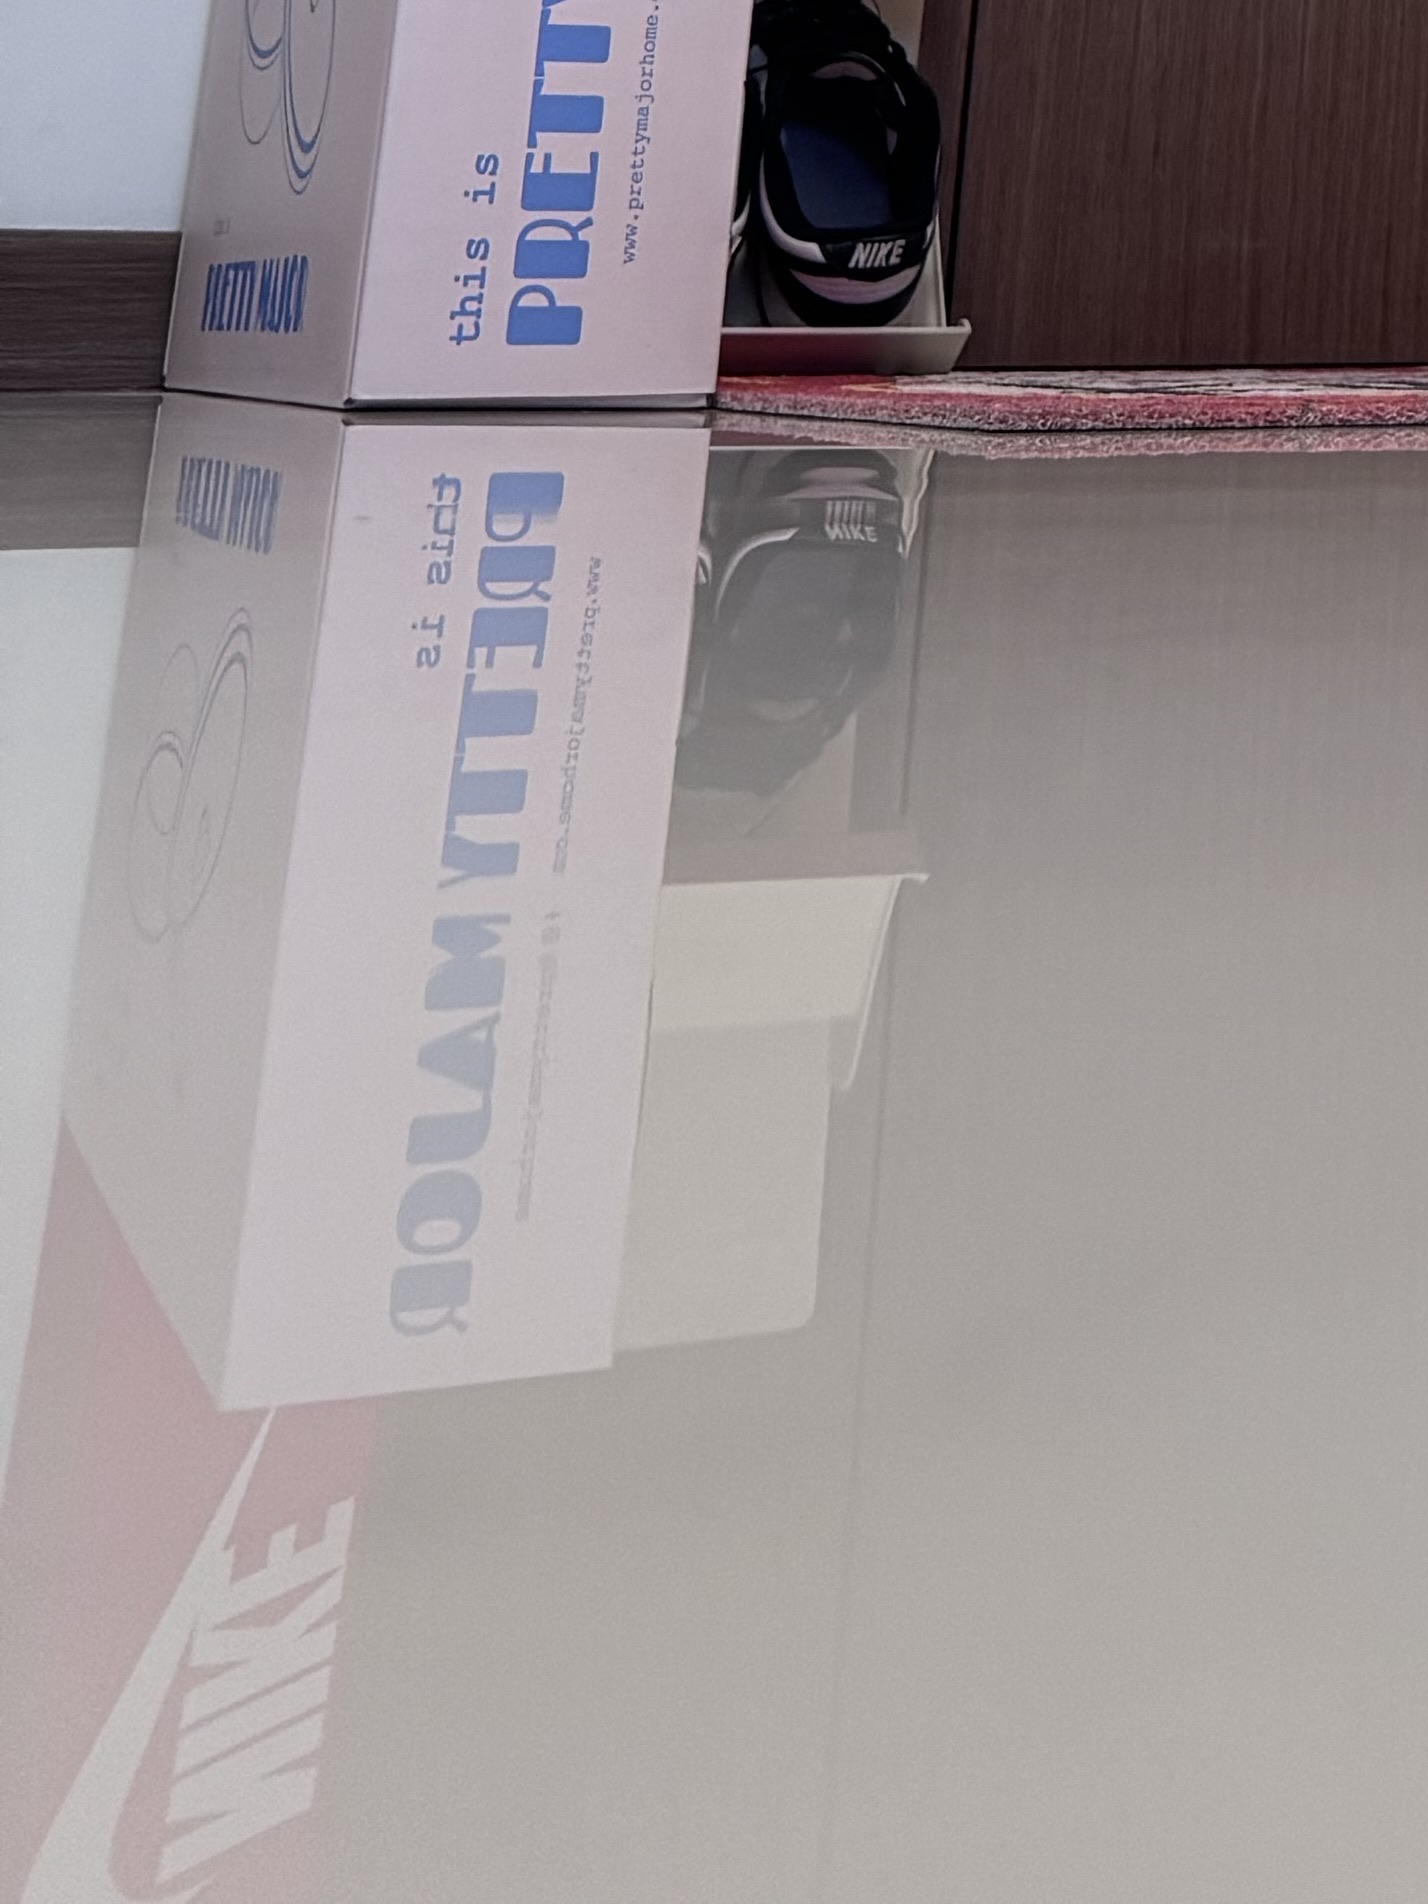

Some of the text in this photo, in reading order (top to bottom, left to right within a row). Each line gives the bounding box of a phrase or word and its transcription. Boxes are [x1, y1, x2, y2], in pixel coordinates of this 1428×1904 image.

[448, 152, 501, 347] this is
[848, 239, 906, 269] NIKE
